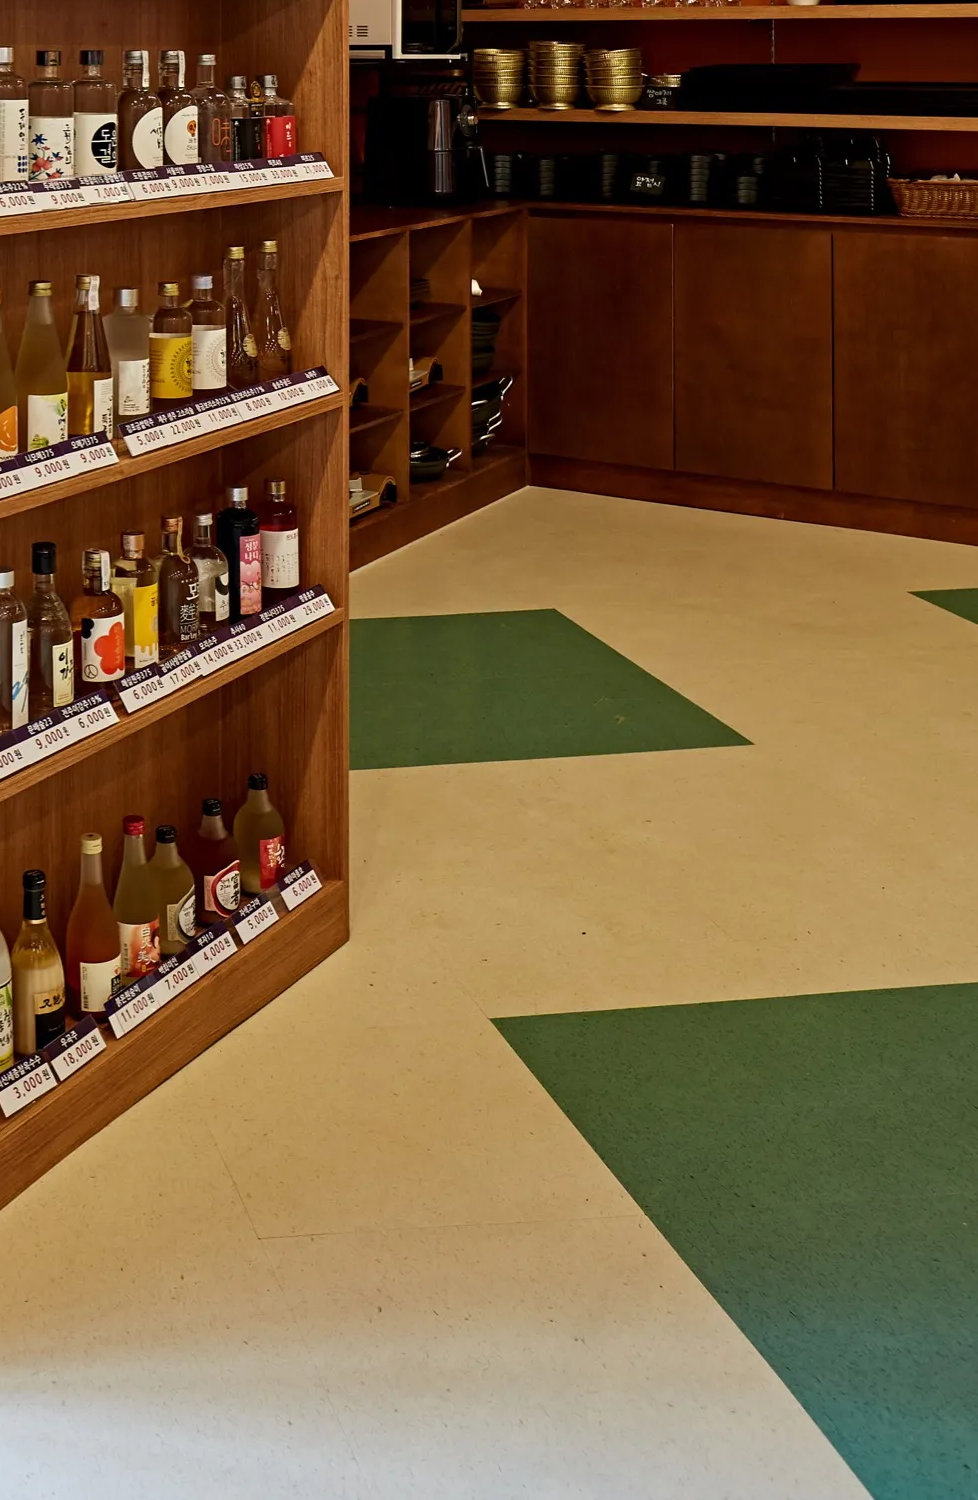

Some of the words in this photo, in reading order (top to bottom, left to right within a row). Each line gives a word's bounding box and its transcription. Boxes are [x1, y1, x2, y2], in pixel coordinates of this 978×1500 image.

[80, 447, 114, 464] 9,000원
[35, 459, 71, 478] 9,000원
[133, 678, 164, 700] 6,000원
[78, 707, 112, 729] 6,000원
[35, 726, 70, 750] 9,000원
[292, 873, 318, 897] 6,000원
[247, 906, 275, 931] 5,000원
[202, 937, 231, 962] 4,000원
[164, 962, 195, 991] 7,000원
[120, 990, 155, 1023] 11,000원
[59, 1030, 78, 1048] 우곡주
[62, 1035, 100, 1067] 18,000원
[15, 1069, 52, 1100] 3,000원
